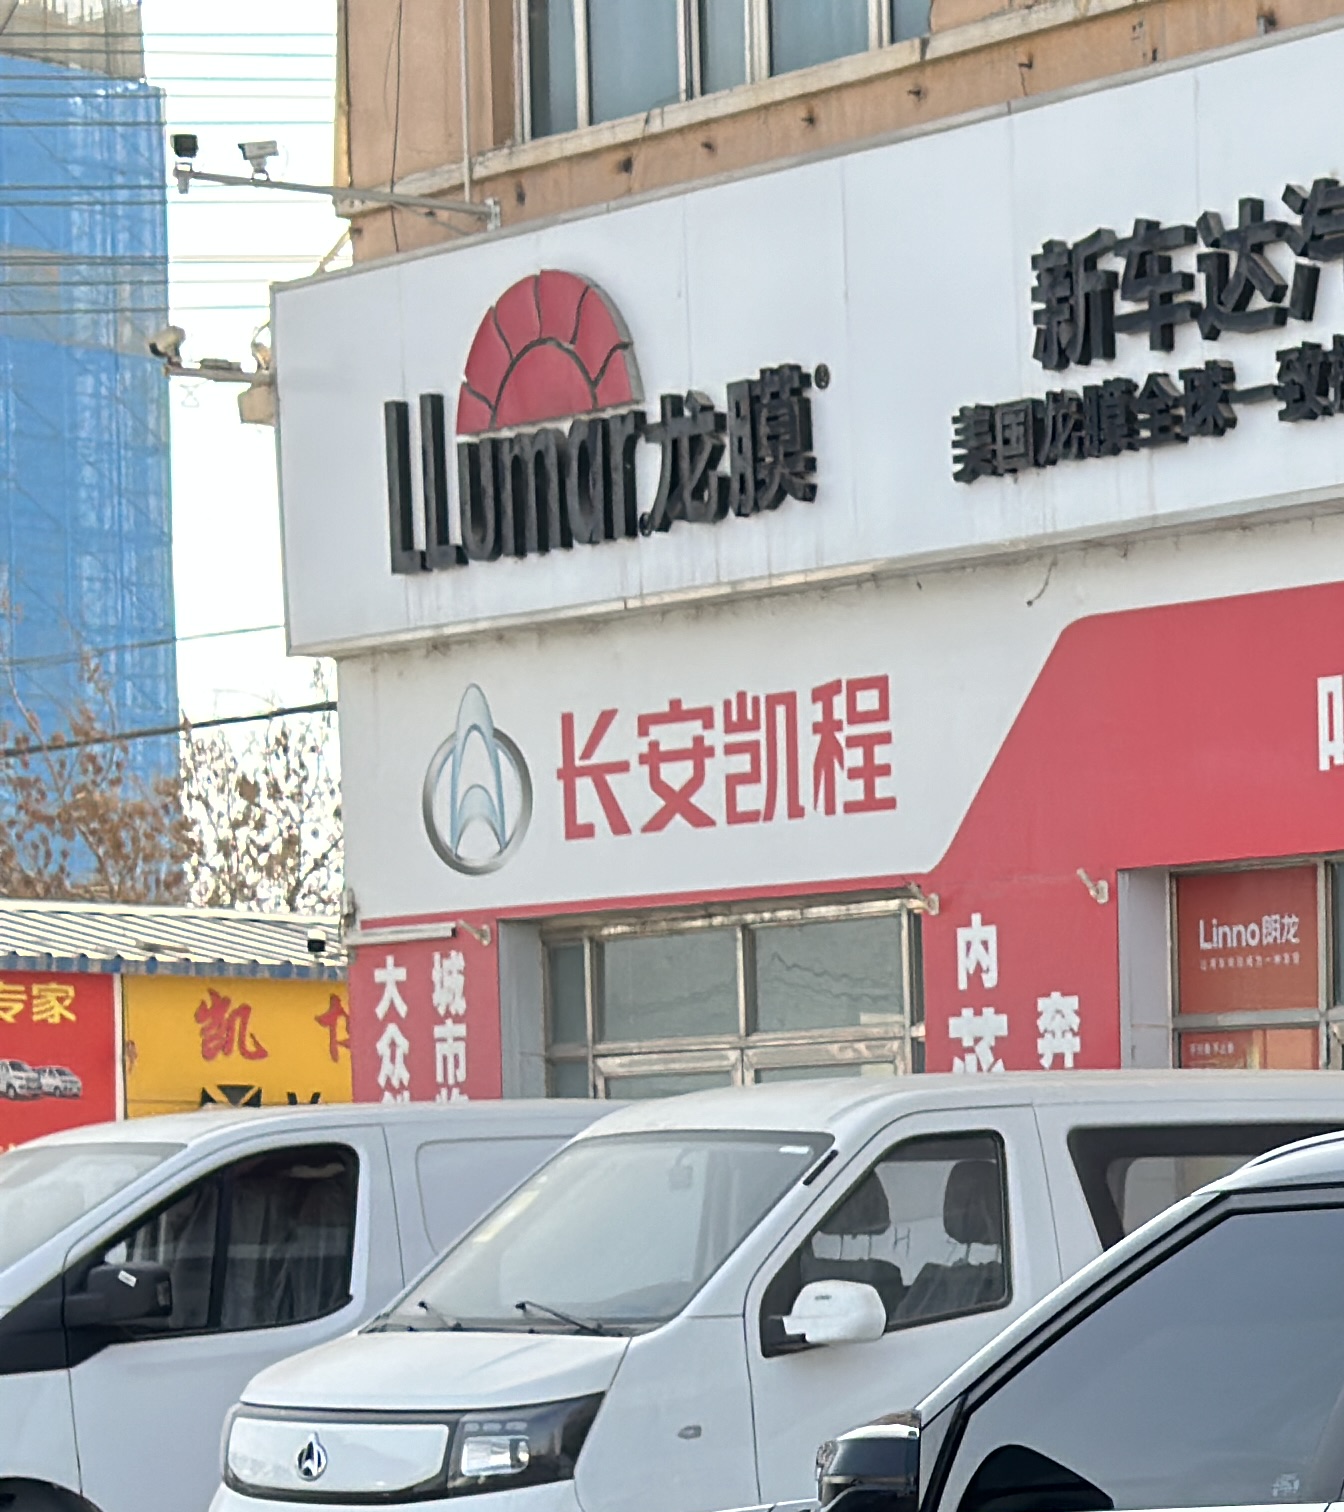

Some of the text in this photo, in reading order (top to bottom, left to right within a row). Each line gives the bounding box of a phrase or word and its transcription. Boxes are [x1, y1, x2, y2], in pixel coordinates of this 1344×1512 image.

[556, 673, 897, 841] 长安凯程
[374, 954, 410, 1104] 大众
